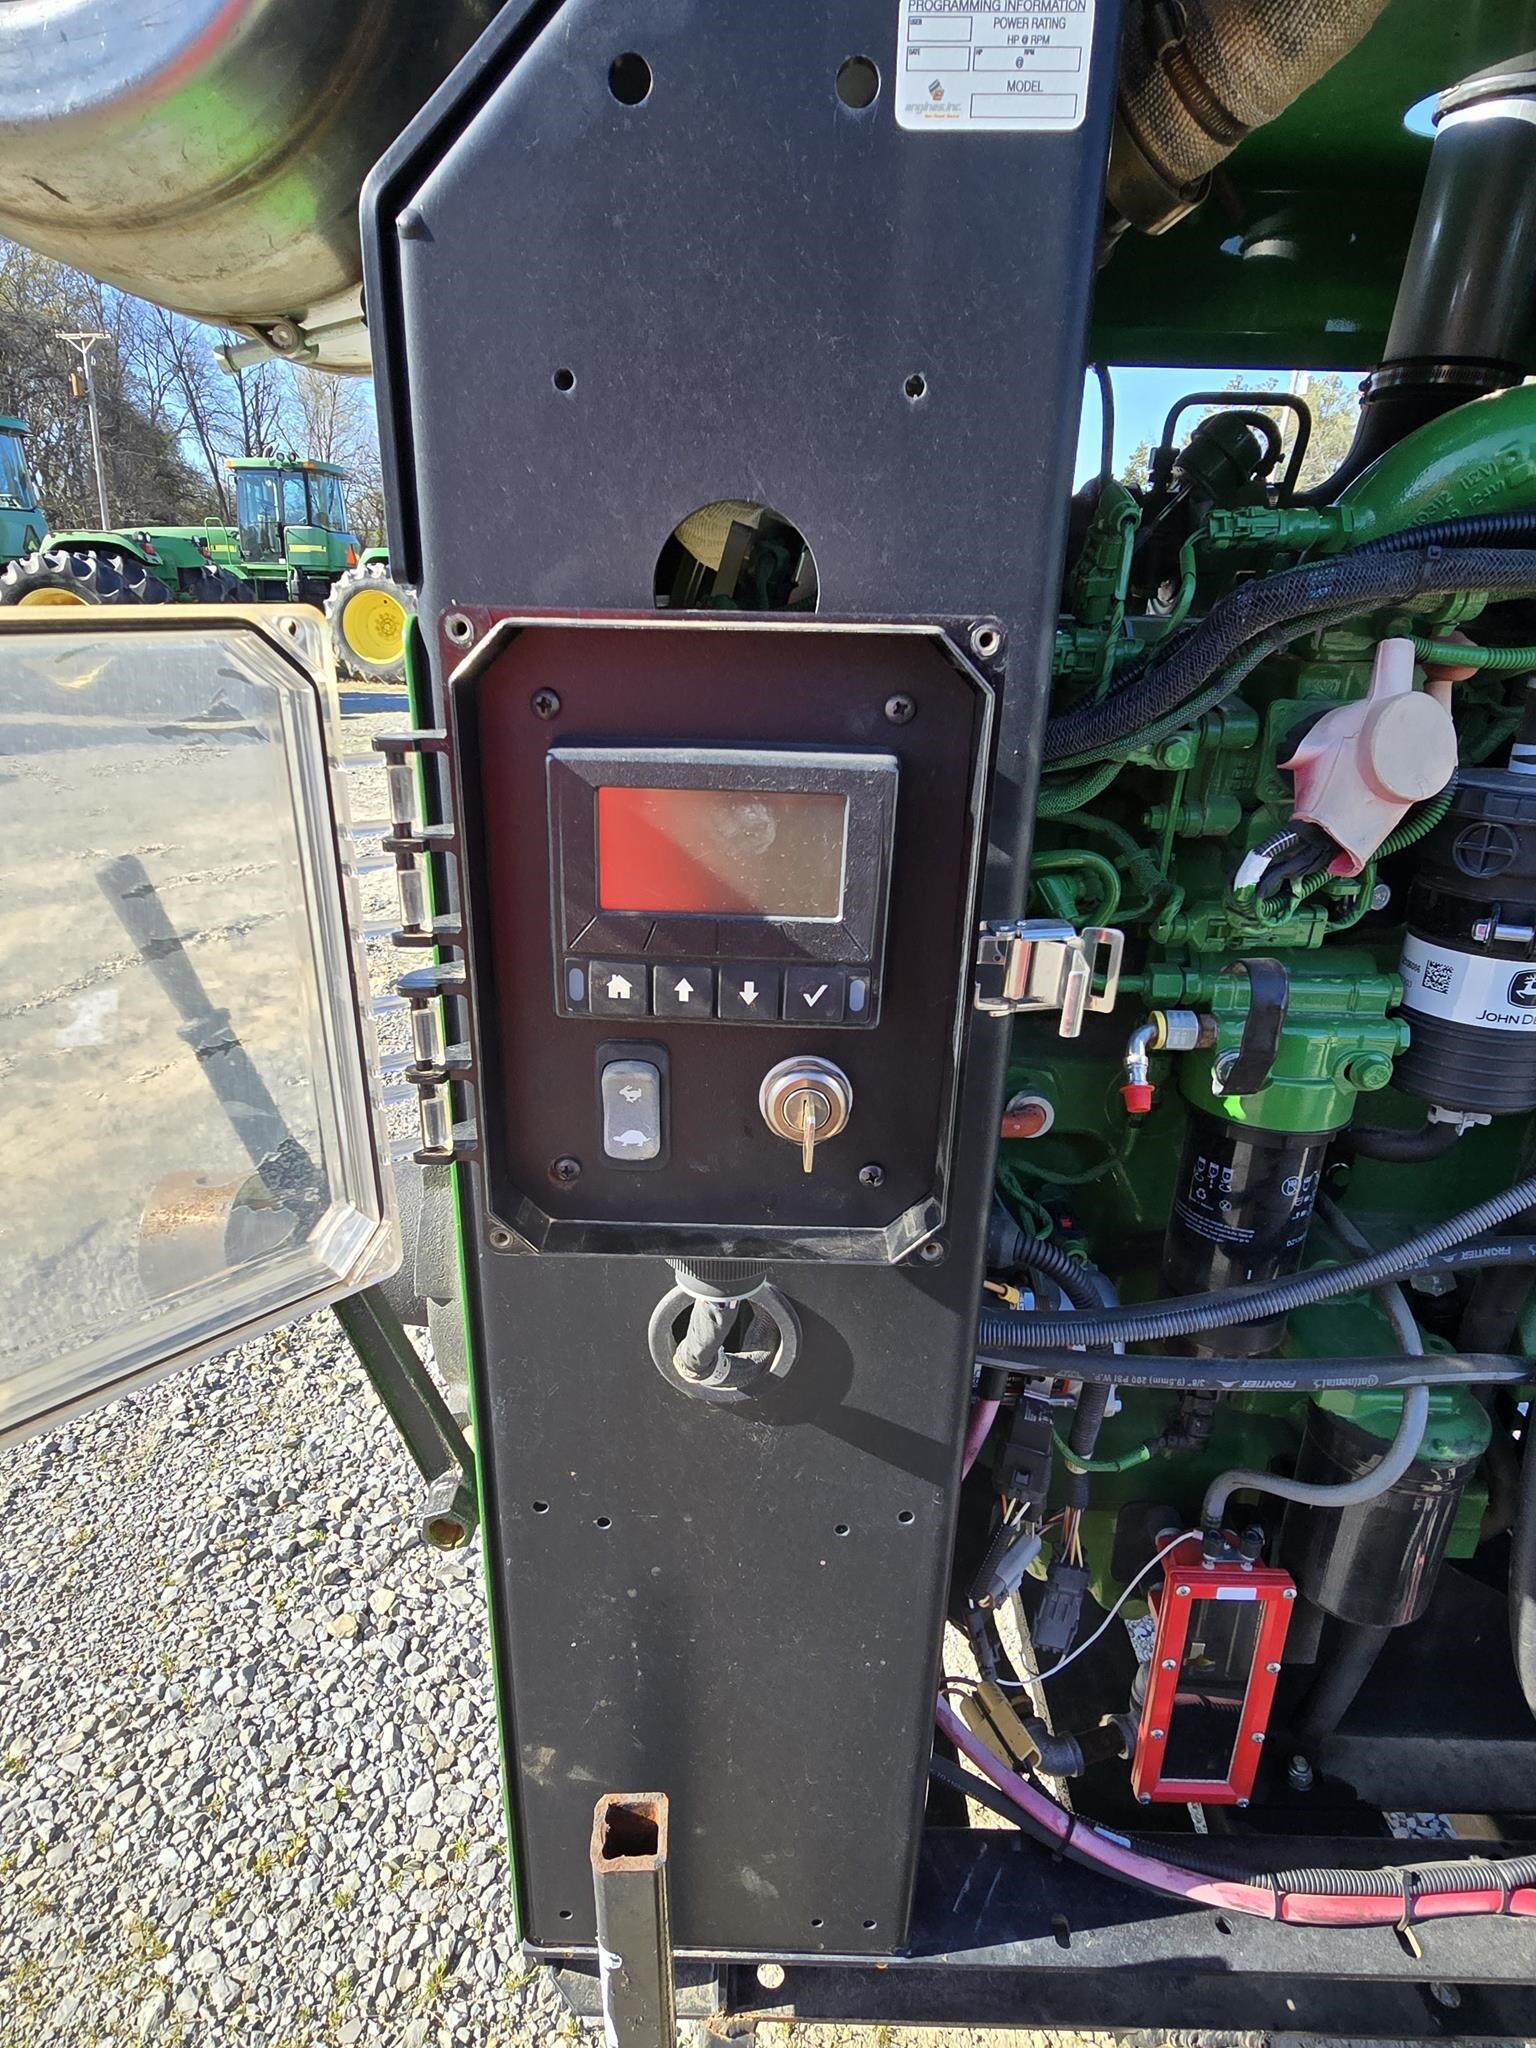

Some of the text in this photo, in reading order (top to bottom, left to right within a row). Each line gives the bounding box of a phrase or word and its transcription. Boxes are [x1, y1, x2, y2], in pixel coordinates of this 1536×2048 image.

[908, 0, 1086, 12] PROGRAMMING INFORMATION
[993, 17, 1066, 29] POWER RATING
[1007, 35, 1019, 45] HP
[1030, 35, 1050, 45] RPM
[1007, 81, 1044, 92] MODEL
[1476, 1010, 1520, 1024] JOHN
[1461, 1246, 1511, 1260] FRONTIER
[1114, 1375, 1129, 1383] PSI
[1131, 1376, 1146, 1385] 200
[1240, 1380, 1297, 1389] FRONTIER
[1321, 1374, 1379, 1388] Continental
